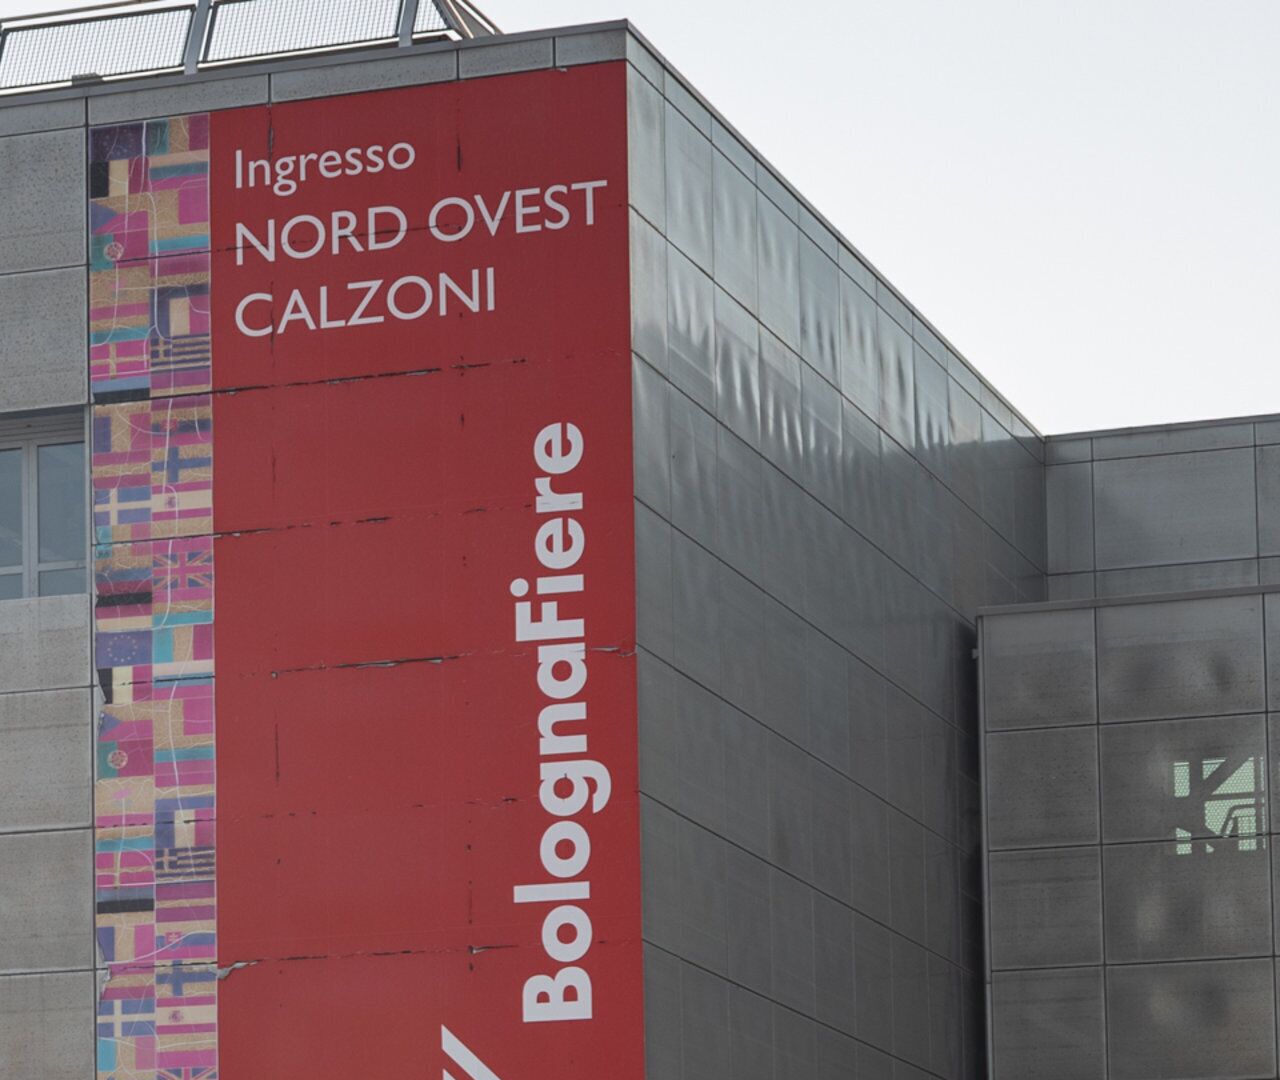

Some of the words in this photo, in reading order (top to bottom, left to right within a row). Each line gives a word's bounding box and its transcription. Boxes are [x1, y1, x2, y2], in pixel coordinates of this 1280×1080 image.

[234, 142, 416, 197] Ingresso
[235, 205, 408, 266] NORD
[428, 179, 608, 243] OVEST
[234, 267, 496, 338] CALZONI
[510, 420, 612, 1024] BolognaFiere
